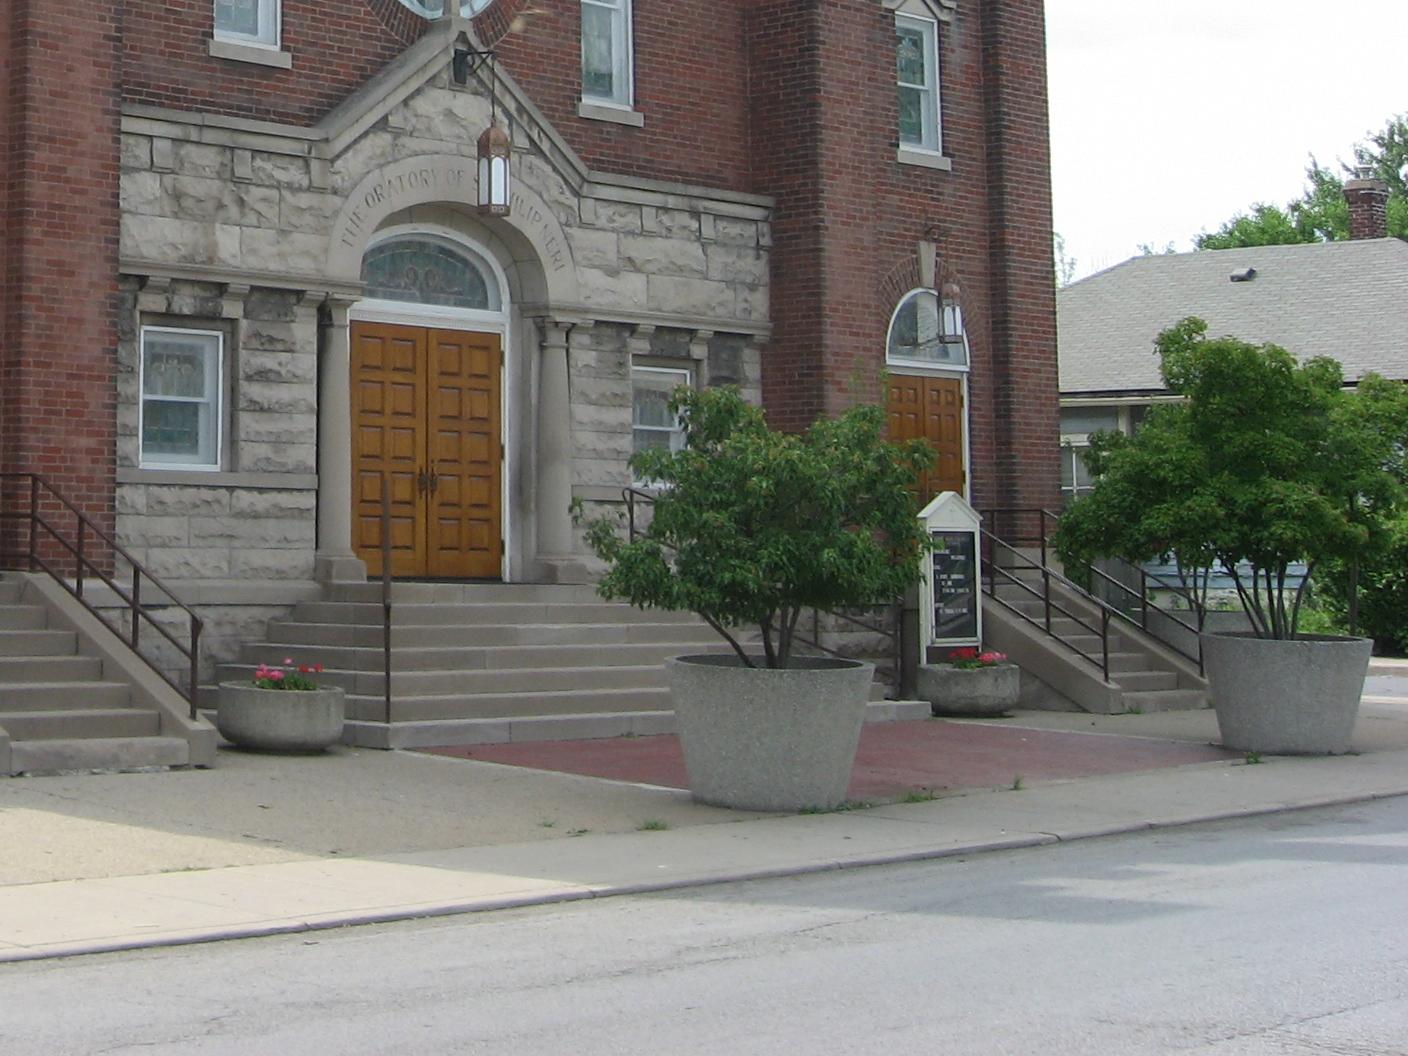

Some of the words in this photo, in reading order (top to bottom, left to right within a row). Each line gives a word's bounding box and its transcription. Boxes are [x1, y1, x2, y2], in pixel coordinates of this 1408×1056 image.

[340, 206, 364, 248] THE
[364, 169, 438, 208] ORATORY
[446, 169, 464, 188] OF
[538, 224, 567, 271] NERI
